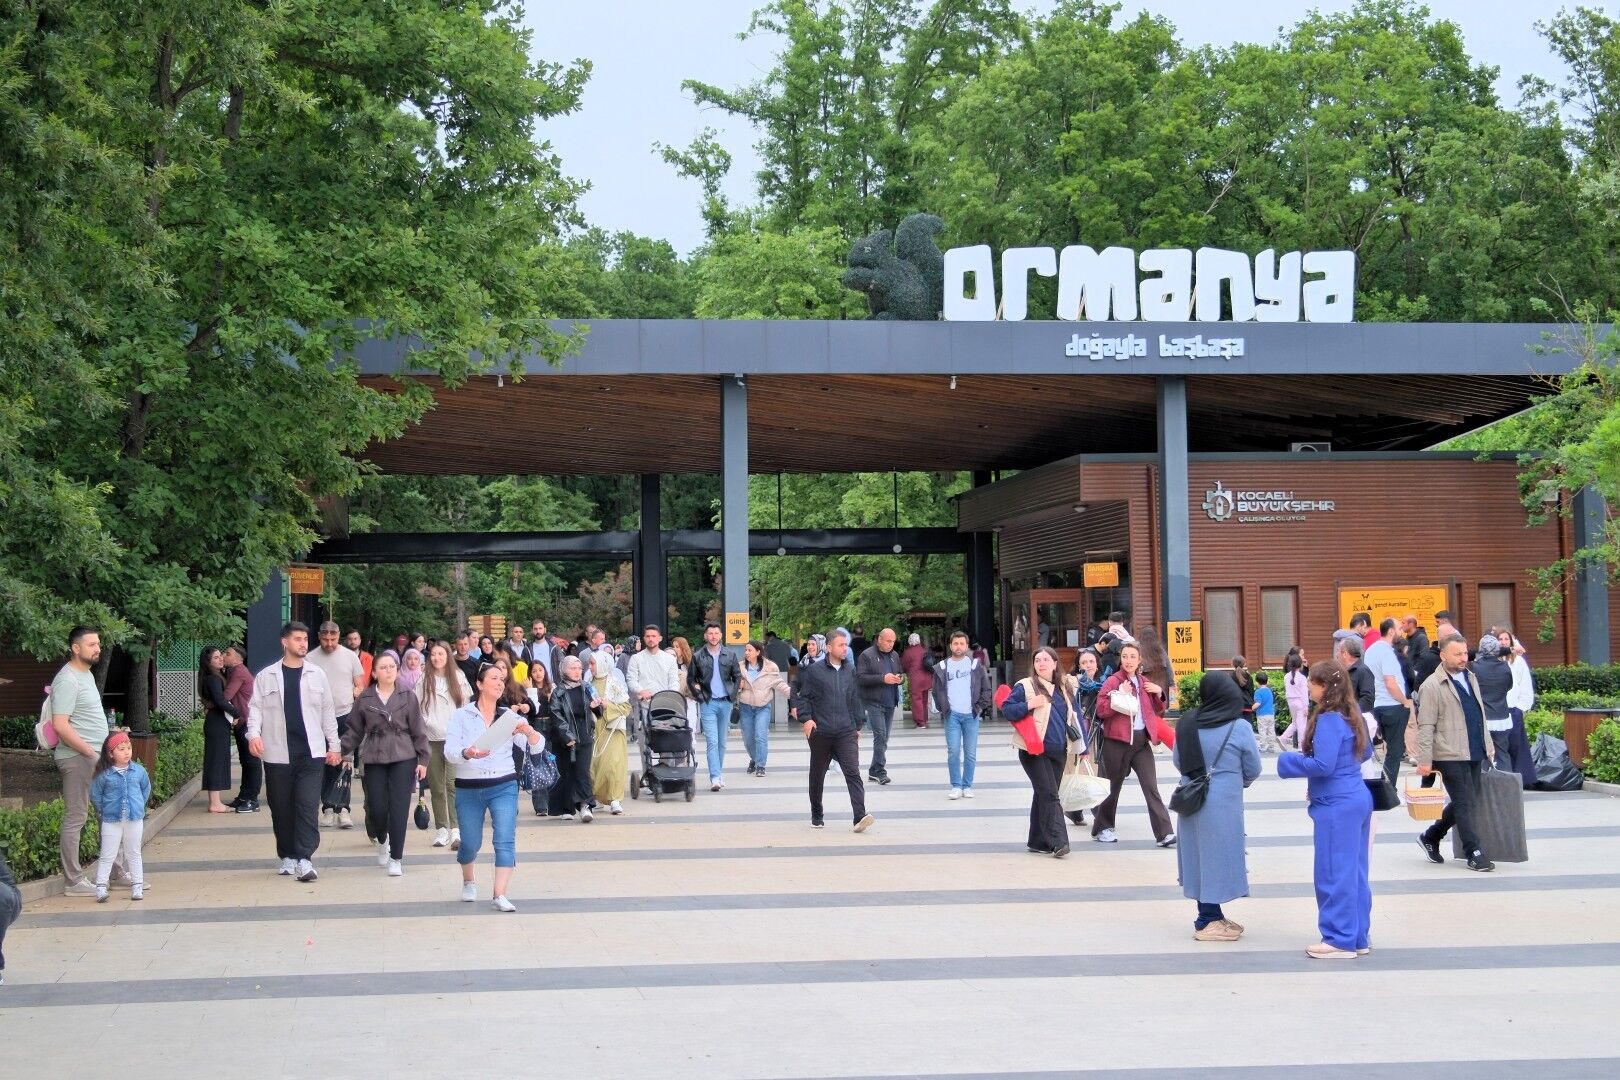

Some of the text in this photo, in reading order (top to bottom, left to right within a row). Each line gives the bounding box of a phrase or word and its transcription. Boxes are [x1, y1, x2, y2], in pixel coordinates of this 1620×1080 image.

[943, 244, 1357, 323] ormanya
[1065, 332, 1246, 361] doğayla başbaşa
[1237, 500, 1336, 513] BÜYÜKŞEHİR
